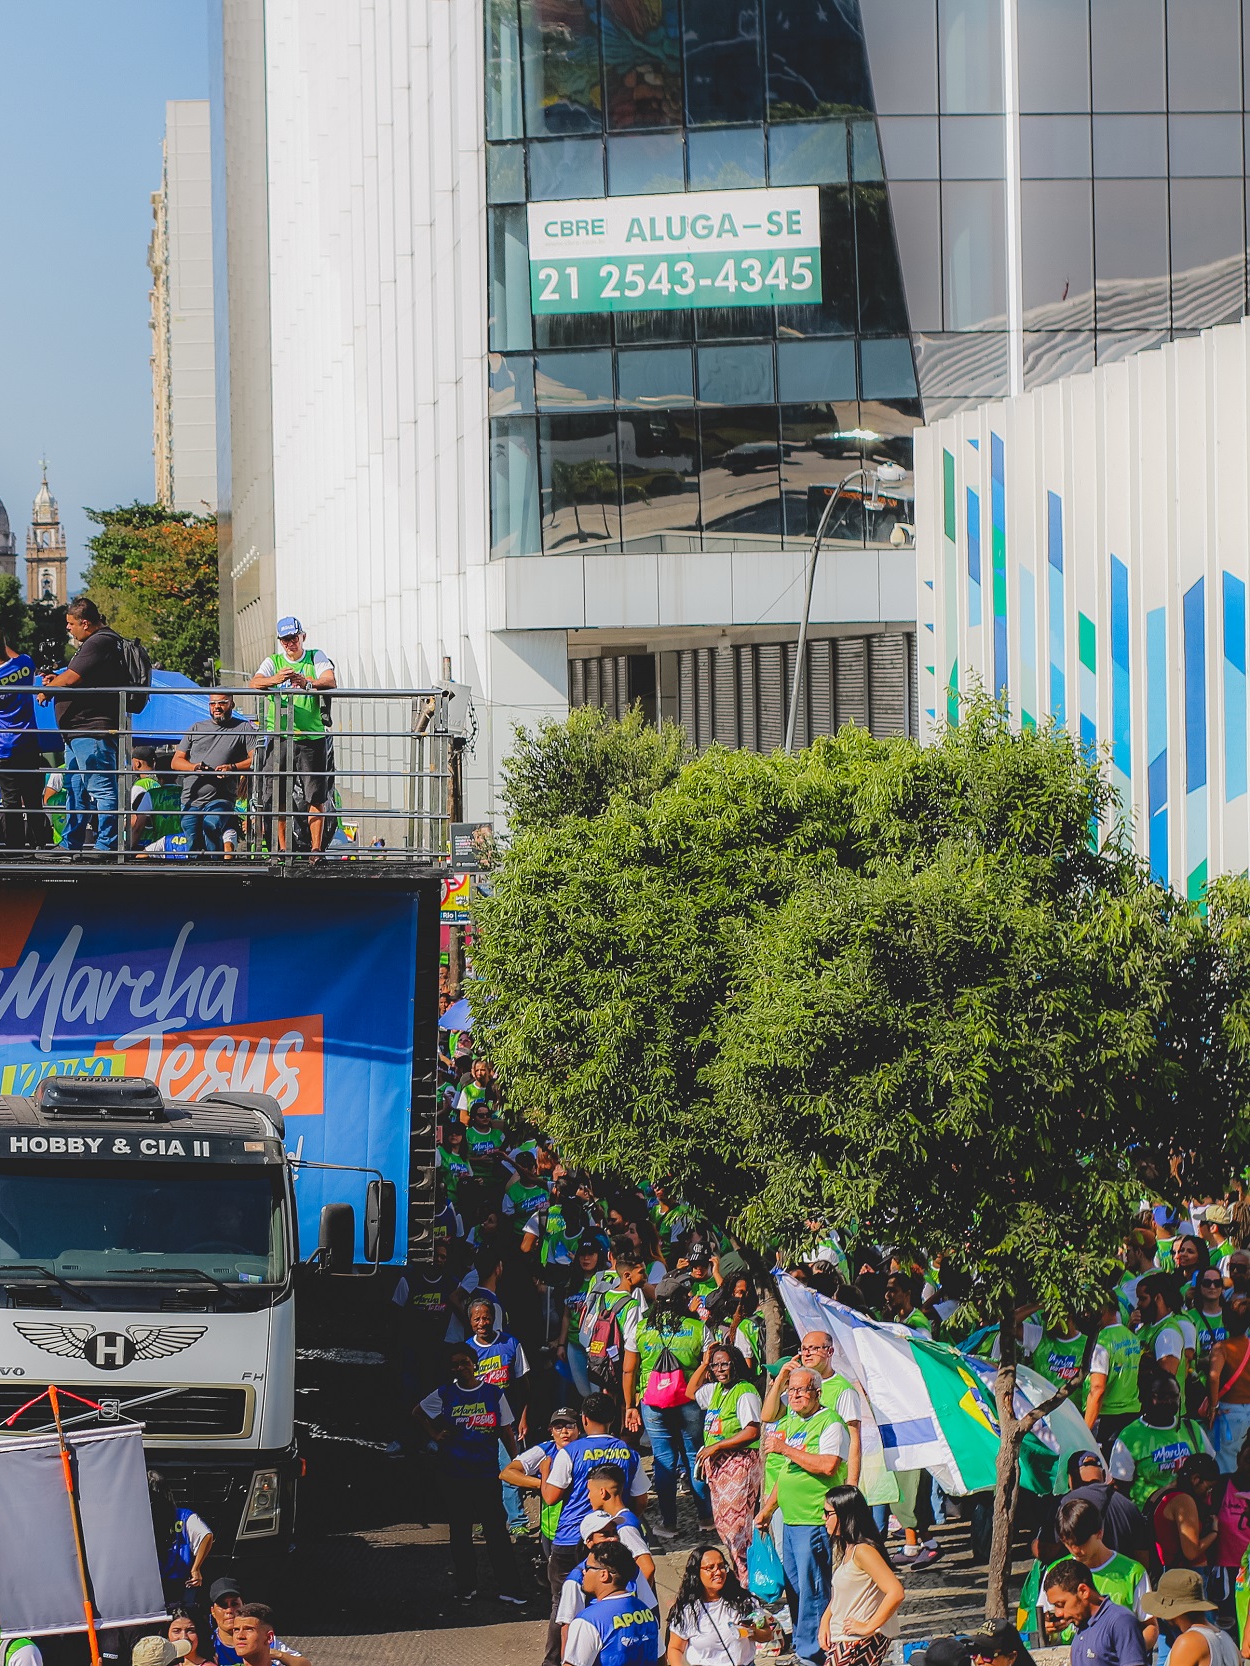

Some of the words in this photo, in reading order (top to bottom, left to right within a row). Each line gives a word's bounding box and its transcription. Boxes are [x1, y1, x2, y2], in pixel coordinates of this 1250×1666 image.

[544, 217, 605, 238] CBRE
[625, 209, 802, 242] ALUGA-SE
[538, 266, 579, 301] 21
[599, 256, 813, 299] 2543-4345
[112, 1017, 305, 1110] Jesus
[9, 1136, 103, 1154] HOBBY
[112, 1137, 131, 1154] &
[139, 1138, 186, 1156] CIA
[193, 1140, 210, 1158] II
[96, 1336, 125, 1365] H
[241, 1371, 265, 1382] FH
[486, 1368, 508, 1384] Jesus
[452, 1402, 485, 1415] Marcha
[455, 1416, 470, 1426] para
[465, 1412, 495, 1429] Jesus
[583, 1448, 631, 1461] APOIO
[1153, 1441, 1190, 1463] Marcha
[1159, 1460, 1176, 1472] para
[612, 1608, 654, 1631] APOIO
